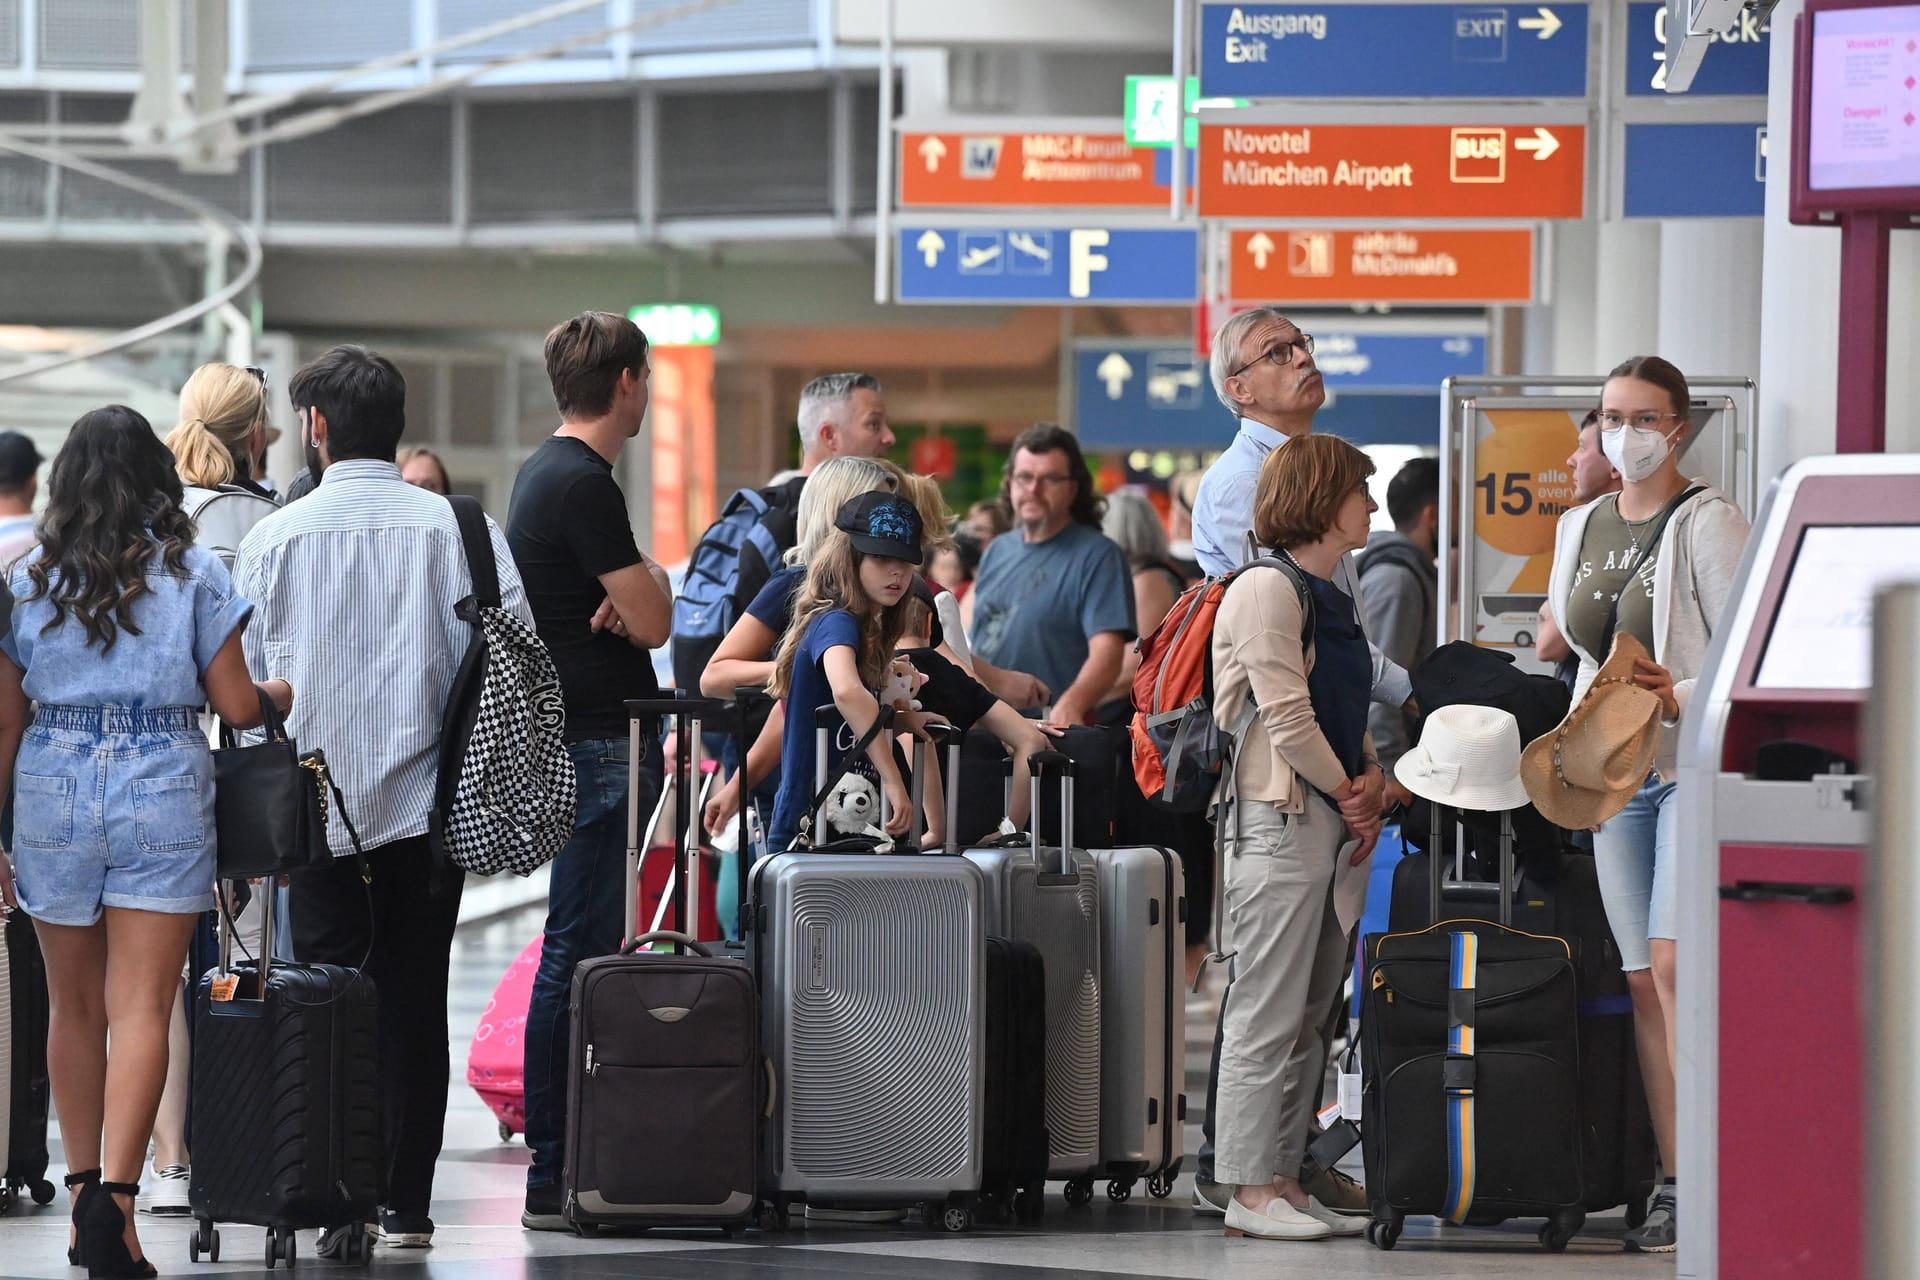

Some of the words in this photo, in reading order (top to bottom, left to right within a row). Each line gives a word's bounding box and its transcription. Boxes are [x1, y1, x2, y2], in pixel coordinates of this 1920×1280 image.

[1227, 8, 1327, 40] Ausgang
[1456, 18, 1506, 38] EXIT
[1225, 36, 1268, 63] Exit
[1223, 128, 1311, 154] Novotel
[1456, 138, 1500, 159] BUS
[1223, 158, 1328, 186] München
[1333, 159, 1413, 191] Airport
[1069, 229, 1110, 298] F
[1538, 469, 1568, 483] alle
[1475, 472, 1533, 516] 15
[1538, 486, 1577, 502] every
